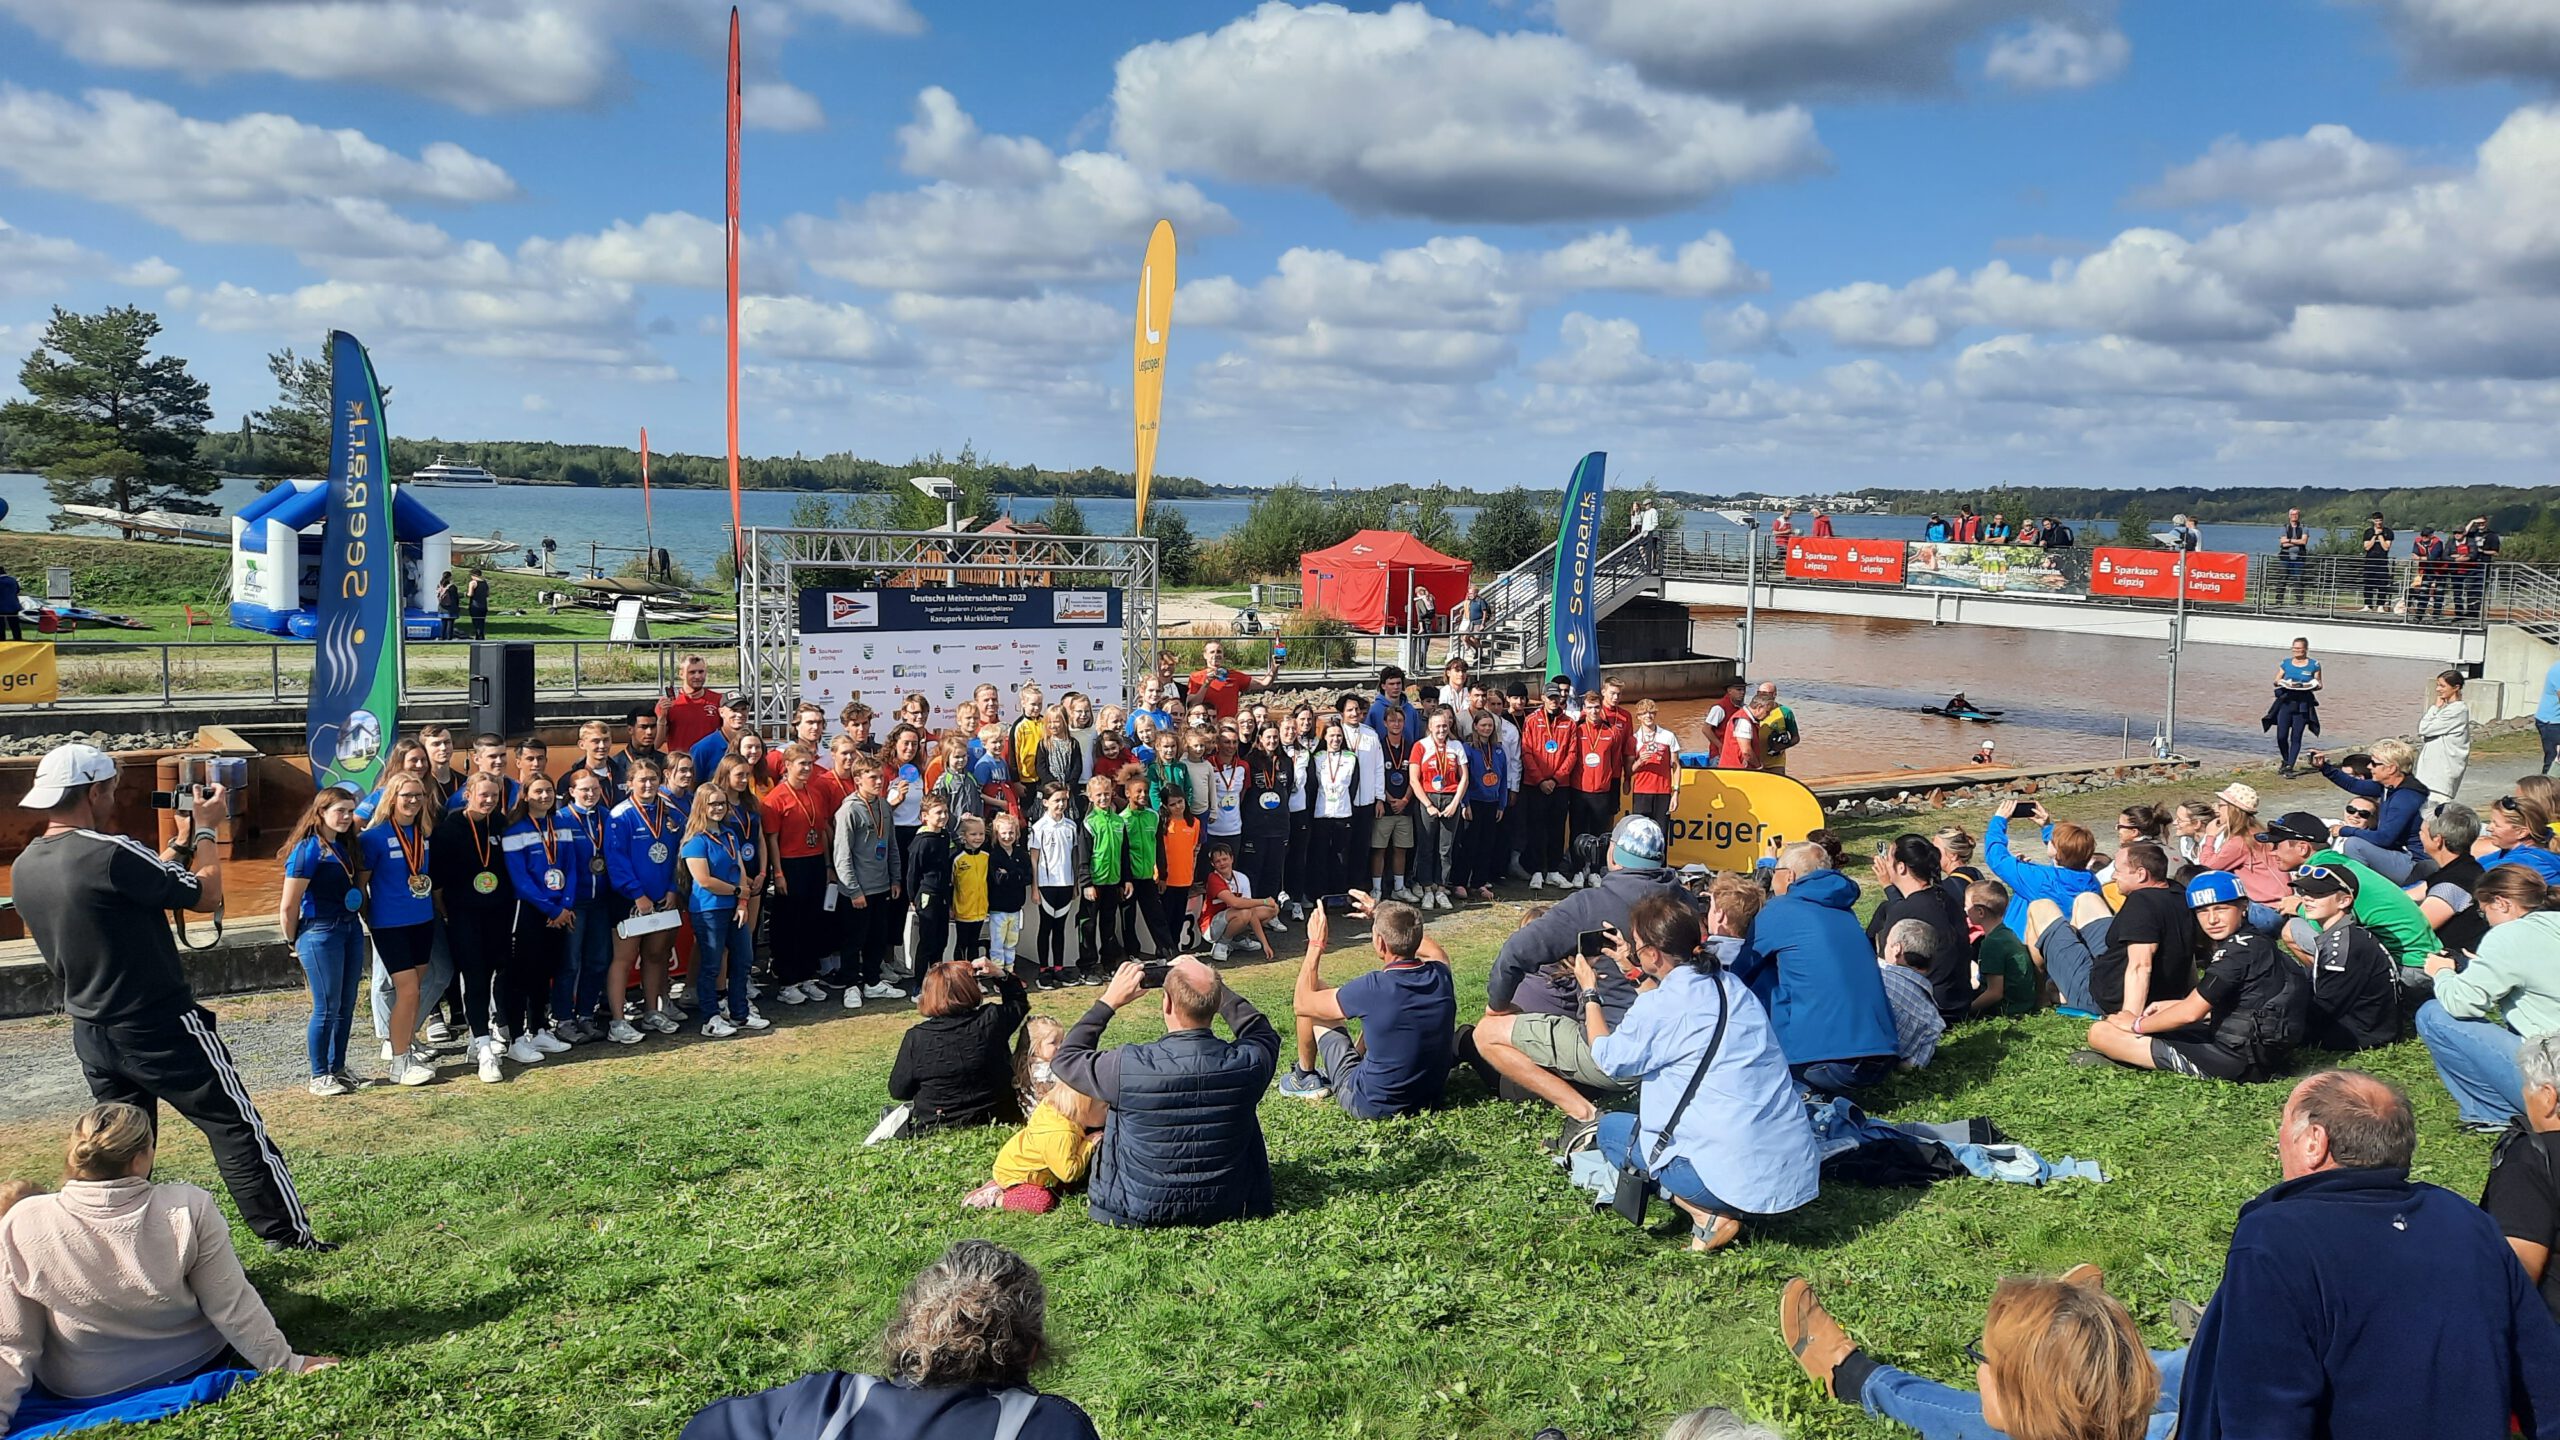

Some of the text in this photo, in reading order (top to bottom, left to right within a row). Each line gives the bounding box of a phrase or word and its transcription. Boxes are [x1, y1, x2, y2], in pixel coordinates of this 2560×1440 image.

[1569, 491, 1592, 616] Seepark
[1804, 551, 1838, 562] Sparkasse
[1860, 554, 1896, 565] Sparkasse
[1803, 562, 1829, 573] Leipzig
[1859, 564, 1884, 575] Leipzig
[2114, 565, 2160, 577] Sparkasse
[2190, 568, 2237, 581] Sparkasse
[2113, 577, 2145, 588] Leipzig
[2189, 580, 2221, 593] Leipzig
[910, 593, 1027, 603] Deutsche Meisterschaften 2023
[924, 606, 943, 614] Jugend
[974, 605, 1014, 614] Leistungsklasse
[930, 614, 1009, 624] Kanupark Markkleeberg
[1668, 812, 1768, 849] pziger
